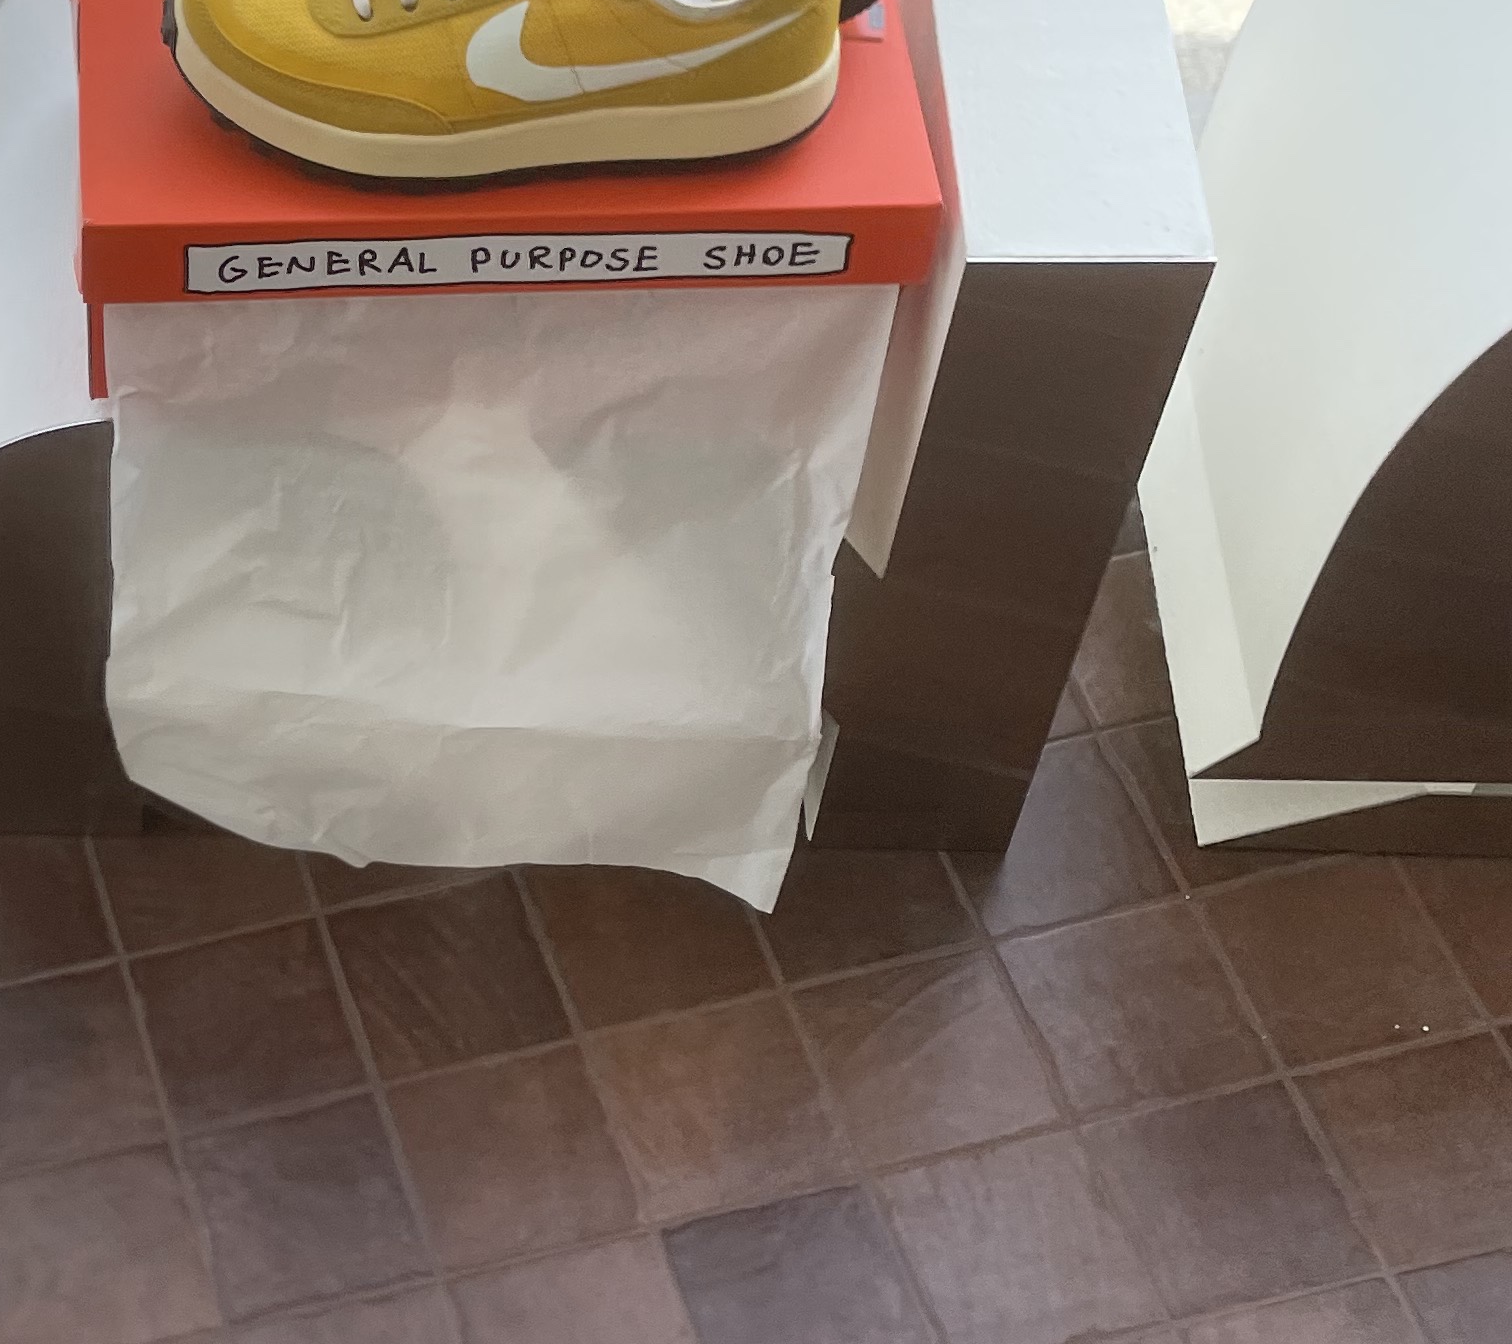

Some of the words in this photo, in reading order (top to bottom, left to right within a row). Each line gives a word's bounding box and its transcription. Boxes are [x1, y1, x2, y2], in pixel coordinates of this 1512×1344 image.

[218, 247, 438, 284] GENERAL
[471, 245, 659, 273] PURPOSE
[703, 242, 821, 270] SHOE
